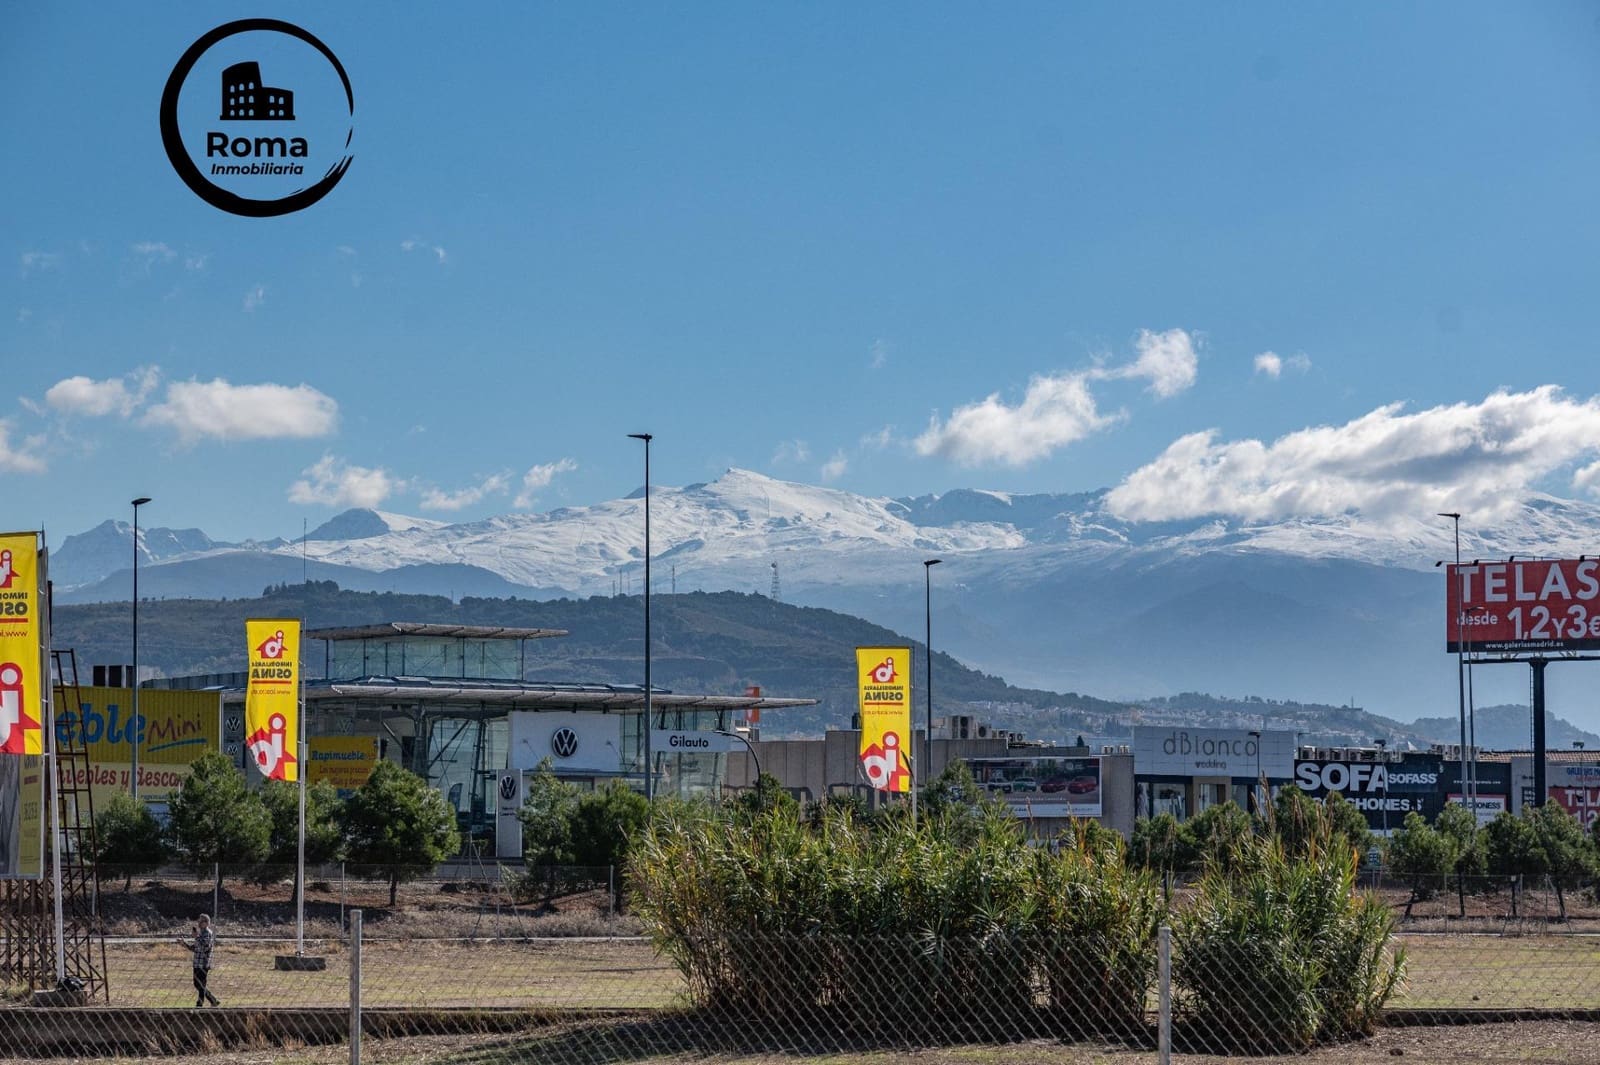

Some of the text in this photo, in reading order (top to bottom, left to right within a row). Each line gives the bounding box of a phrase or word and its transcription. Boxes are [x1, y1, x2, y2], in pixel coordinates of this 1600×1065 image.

[1455, 561, 1600, 603] TELAS
[1457, 611, 1498, 625] desde
[147, 714, 203, 745] Mini
[669, 735, 709, 748] Gilauto
[1296, 763, 1437, 792] SOFA SOFASS
